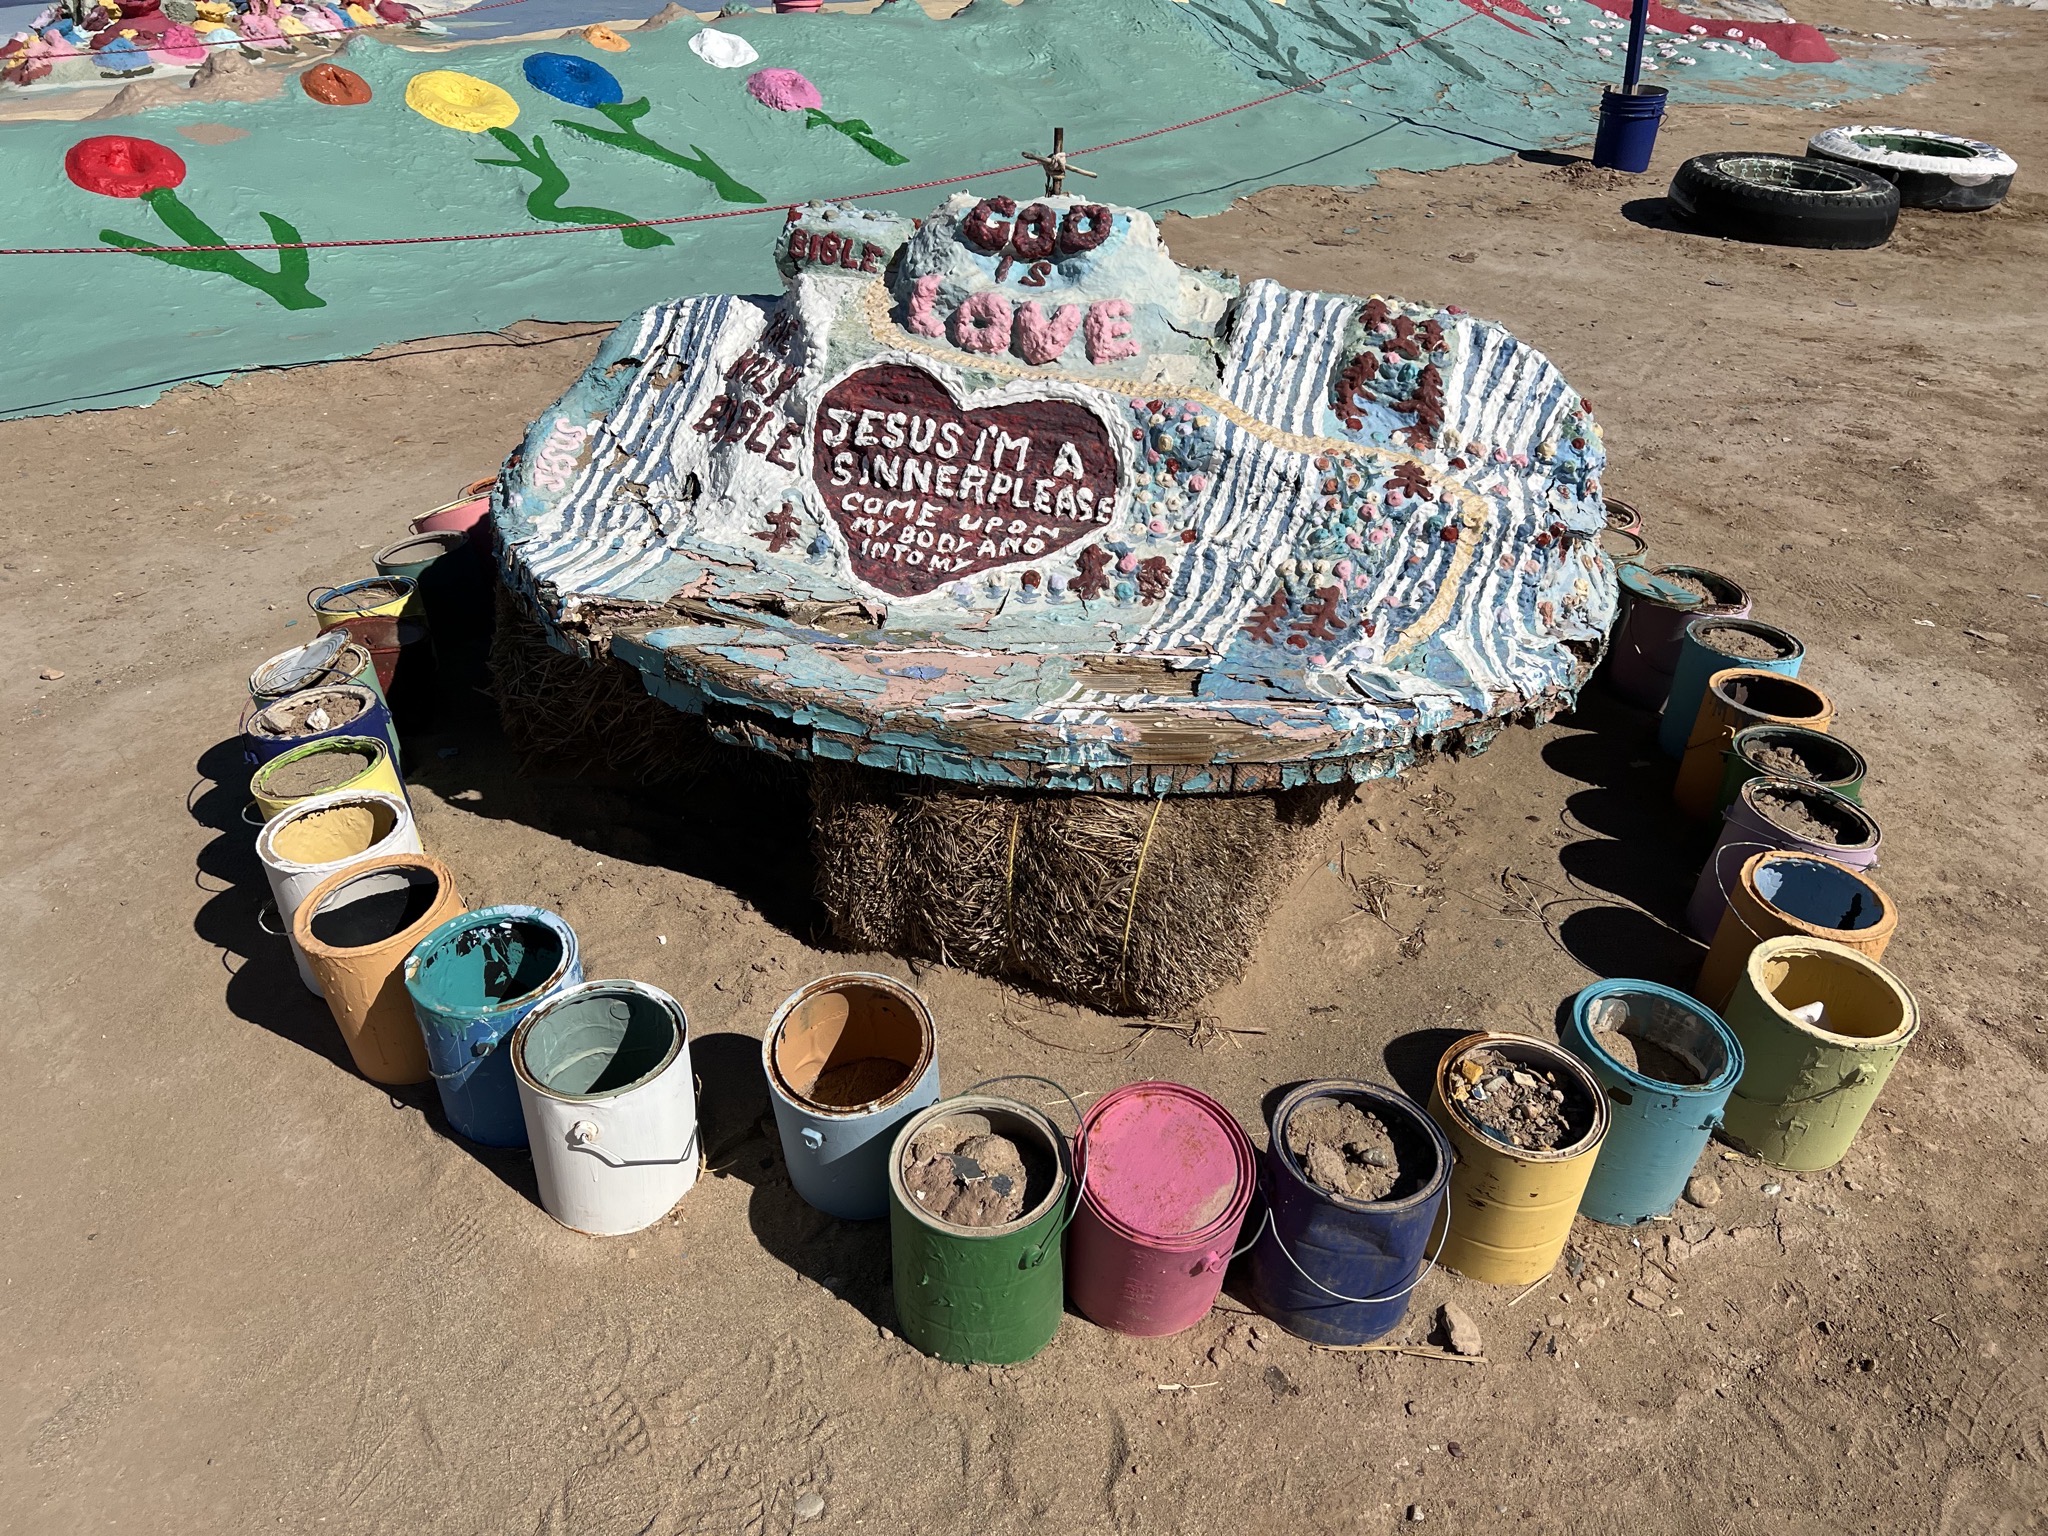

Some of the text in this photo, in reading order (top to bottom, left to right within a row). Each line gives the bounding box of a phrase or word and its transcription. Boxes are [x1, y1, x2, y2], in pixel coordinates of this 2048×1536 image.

[789, 228, 884, 273] BIBLE
[962, 195, 1112, 258] GOD
[908, 274, 1141, 366] LOVE
[723, 349, 805, 407] HOLY
[693, 394, 805, 471] BIBLE
[822, 408, 1084, 480] JESUS I'M A
[841, 492, 1060, 539] COME UPON
[987, 472, 1114, 523] PLEASE
[851, 516, 1046, 558] MY BODY AND
[860, 538, 974, 573] INTO MY
